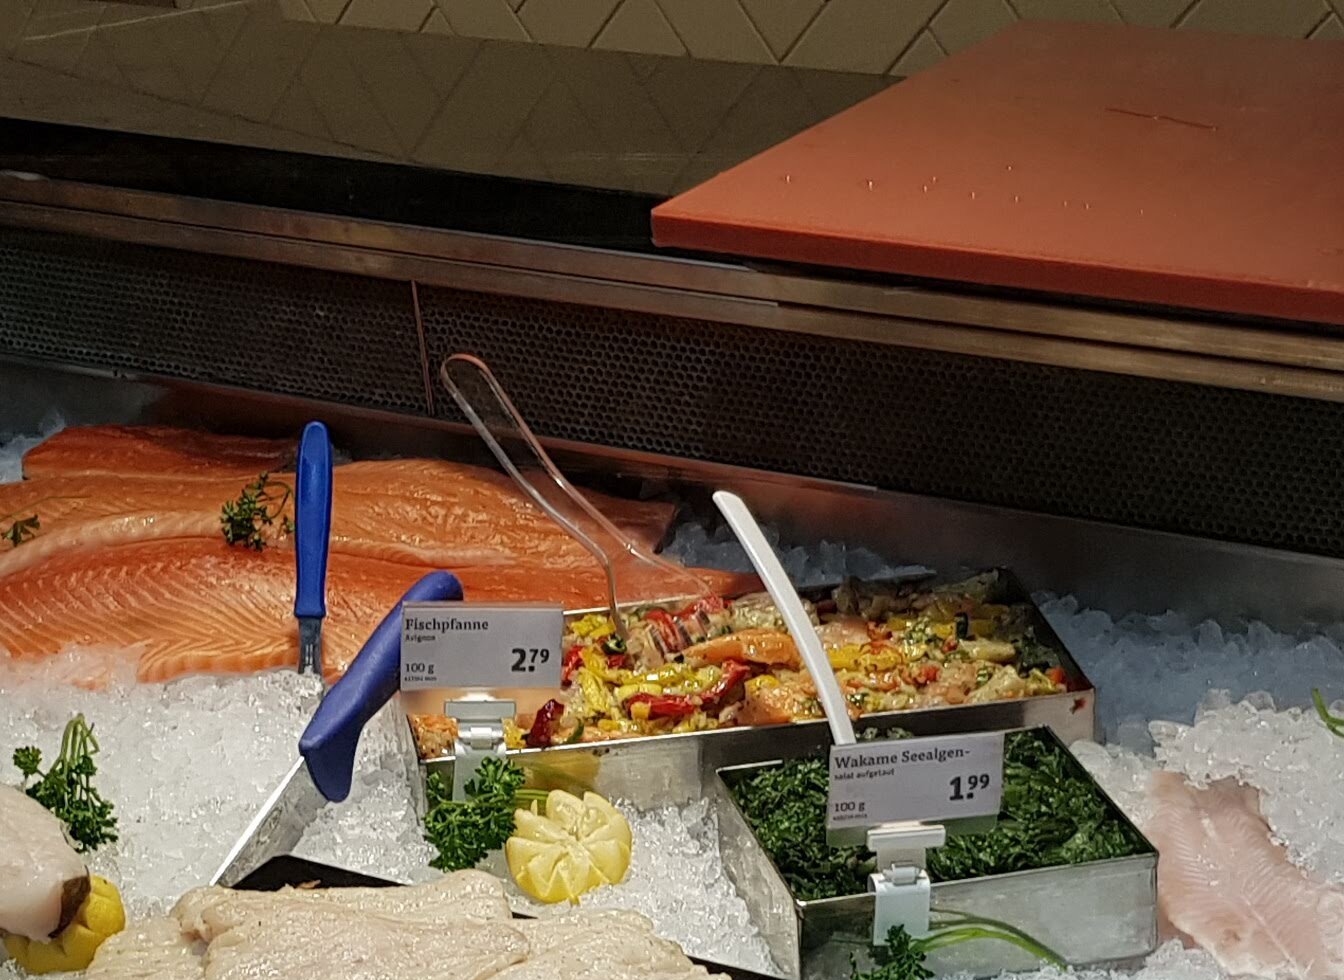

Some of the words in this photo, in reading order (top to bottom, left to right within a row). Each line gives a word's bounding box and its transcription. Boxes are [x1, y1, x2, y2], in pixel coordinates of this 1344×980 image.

[405, 618, 489, 633] Fischpfanne
[405, 663, 425, 673] 100
[428, 664, 434, 674] g
[511, 648, 550, 672] 2.79
[834, 754, 898, 769] Wakame
[901, 748, 971, 763] Seealgen-
[949, 774, 990, 801] 1.99
[834, 802, 855, 812] 100
[858, 803, 865, 812] g
